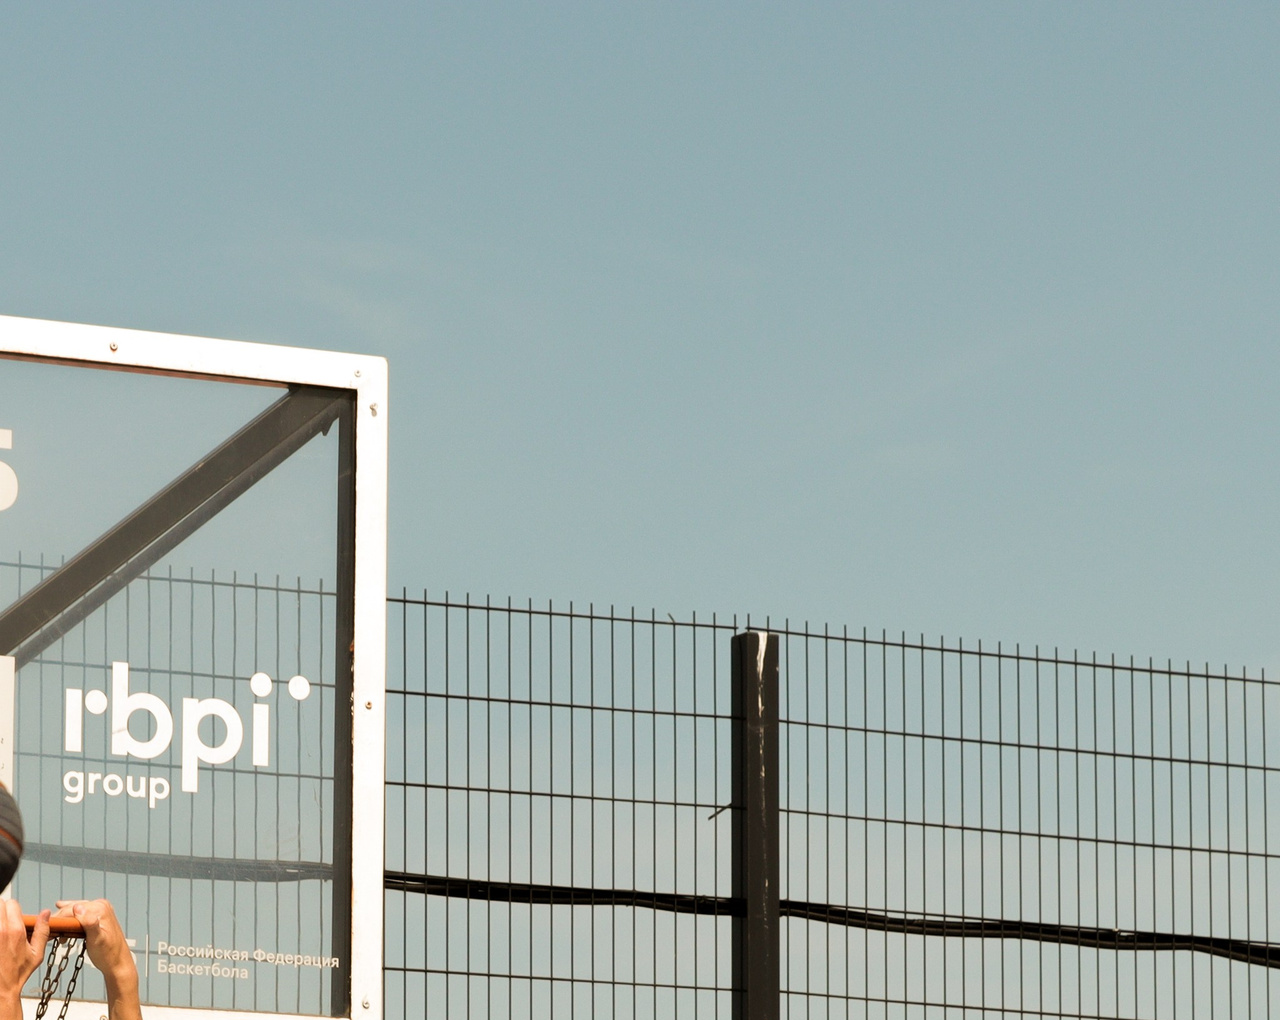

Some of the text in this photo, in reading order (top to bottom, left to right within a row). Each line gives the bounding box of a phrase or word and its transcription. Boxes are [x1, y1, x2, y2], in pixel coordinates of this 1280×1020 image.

[63, 770, 170, 809] group
[157, 941, 249, 962] Российская
[253, 949, 340, 969] Федерация
[157, 958, 249, 980] Баскетбола
